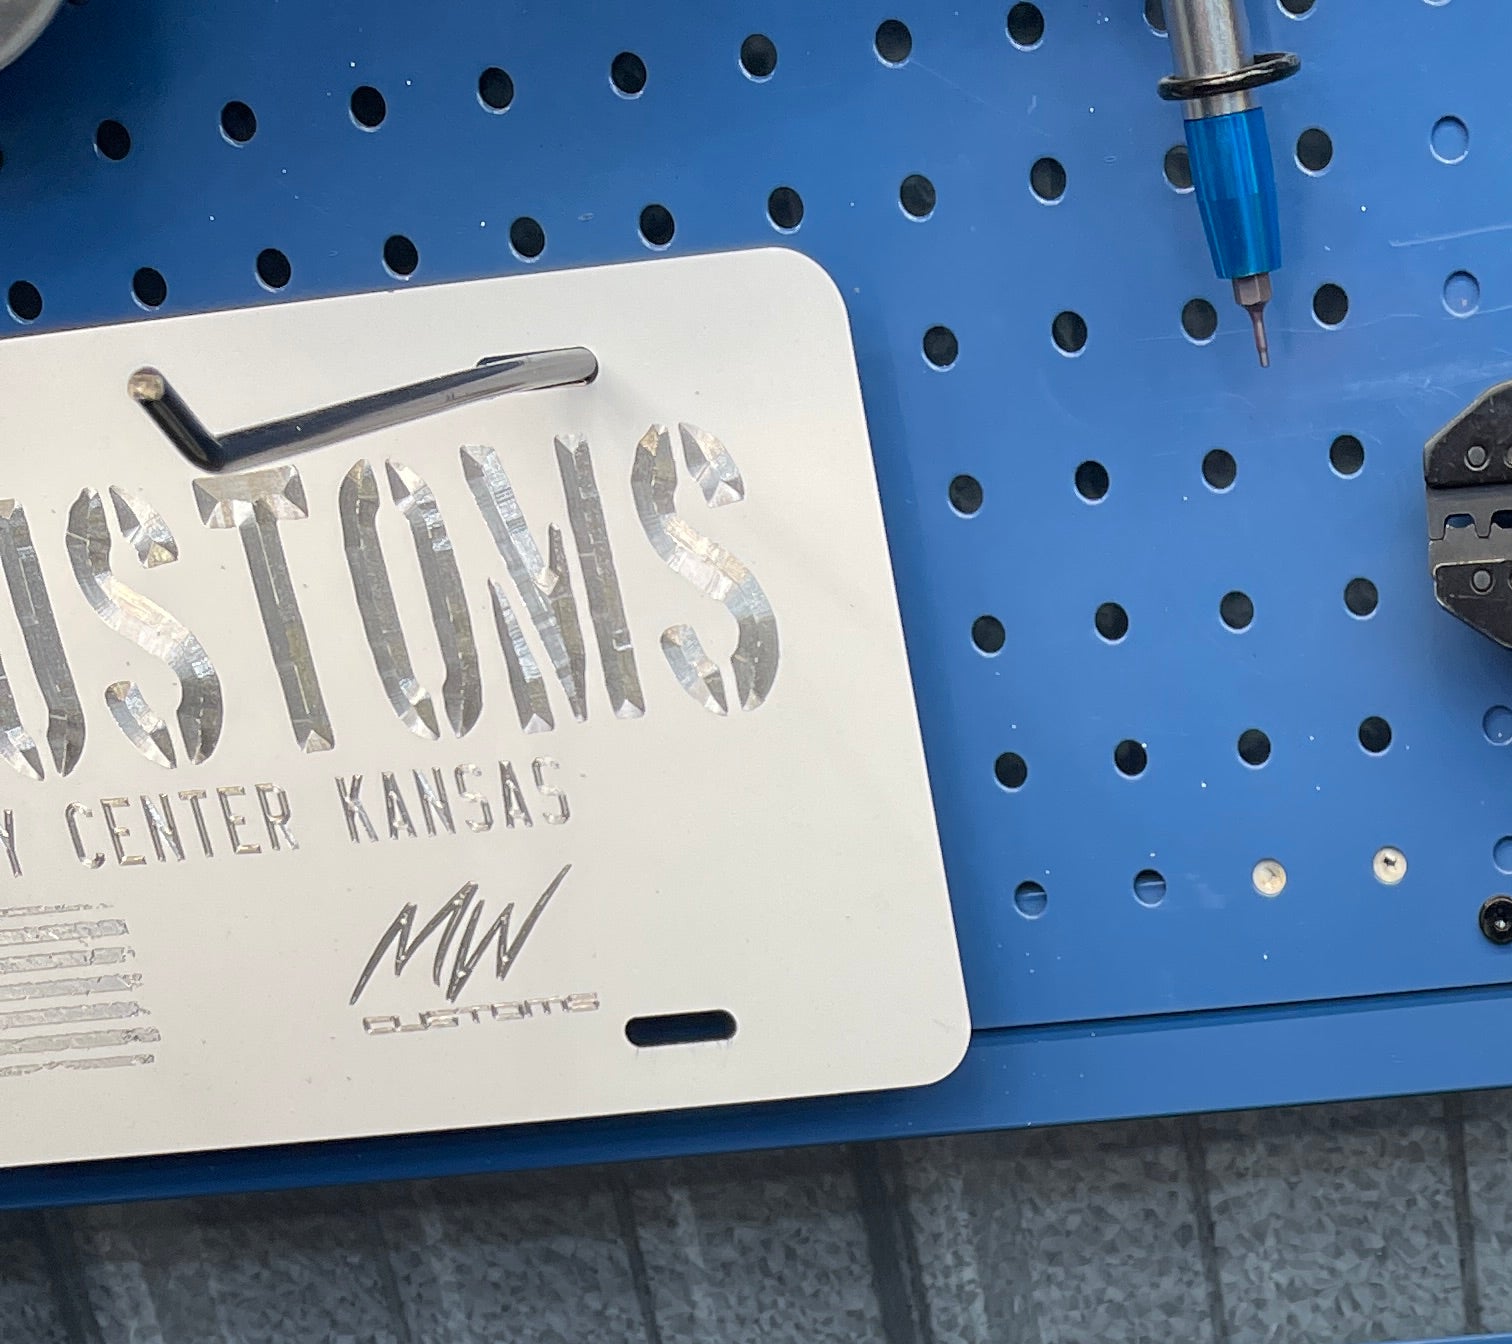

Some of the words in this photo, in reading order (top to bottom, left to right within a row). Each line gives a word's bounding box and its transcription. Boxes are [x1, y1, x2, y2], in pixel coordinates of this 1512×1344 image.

[64, 781, 299, 870] CENTER
[335, 756, 571, 844] KANSAS
[349, 864, 572, 1006] MW
[362, 992, 601, 1036] CUSTOMS
